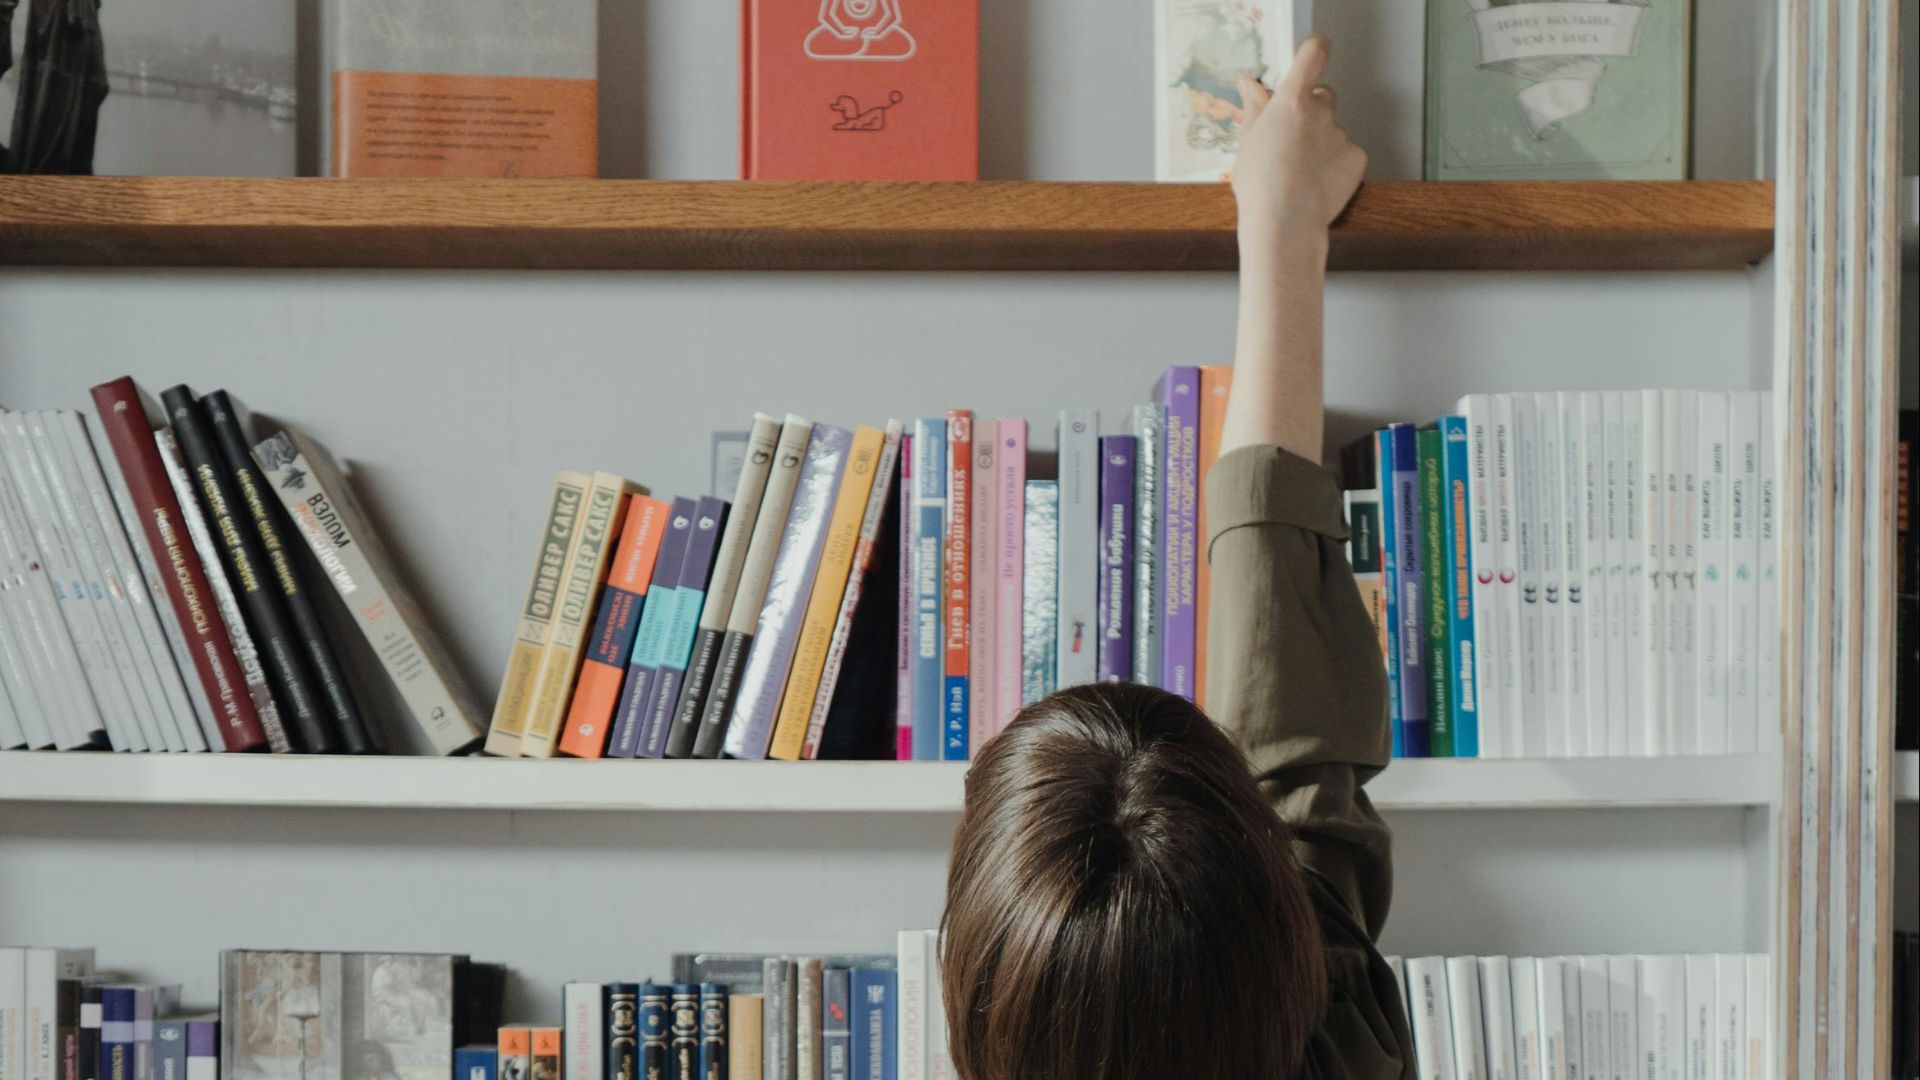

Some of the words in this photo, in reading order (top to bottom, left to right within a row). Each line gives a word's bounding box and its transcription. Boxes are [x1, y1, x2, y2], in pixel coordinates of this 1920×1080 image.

[1166, 415, 1182, 510] АКЦЕНТУАЦИИ
[1180, 426, 1195, 515] ПОДРОСТКОВ
[195, 461, 228, 517] ЖИЗНИ
[235, 466, 266, 519] ЖИЗНИ
[1005, 466, 1017, 508] устала
[217, 514, 242, 548] ДЛЯ
[257, 518, 280, 550] ДЛЯ
[306, 490, 350, 550] ВЗЛОМ
[952, 468, 965, 583] отношениях
[1004, 512, 1017, 557] просто
[1107, 503, 1125, 565] бабушки
[1166, 514, 1178, 523] И
[1181, 519, 1193, 528] У
[230, 545, 260, 593] МИФЫ
[269, 548, 298, 596] МИФЫ
[527, 539, 567, 617] ОЛИВЕР
[548, 490, 579, 539] САКС
[559, 541, 599, 620] ОЛИВЕР
[582, 492, 612, 542] САКС
[920, 536, 936, 595] КРИЗИСЕ
[1002, 562, 1013, 577] Не
[1165, 526, 1180, 615] ПСИХОПАТИИ
[1179, 532, 1193, 604] ХАРАКТЕРА
[167, 546, 210, 635] ПСИХОЛОГИЯ
[920, 598, 935, 609] В
[952, 588, 963, 599] в
[1107, 567, 1122, 638] Рождение
[919, 612, 935, 657] СЕМЬЯ
[948, 605, 963, 650] Гнев
[679, 698, 696, 723] Кей
[707, 699, 724, 724] Кей
